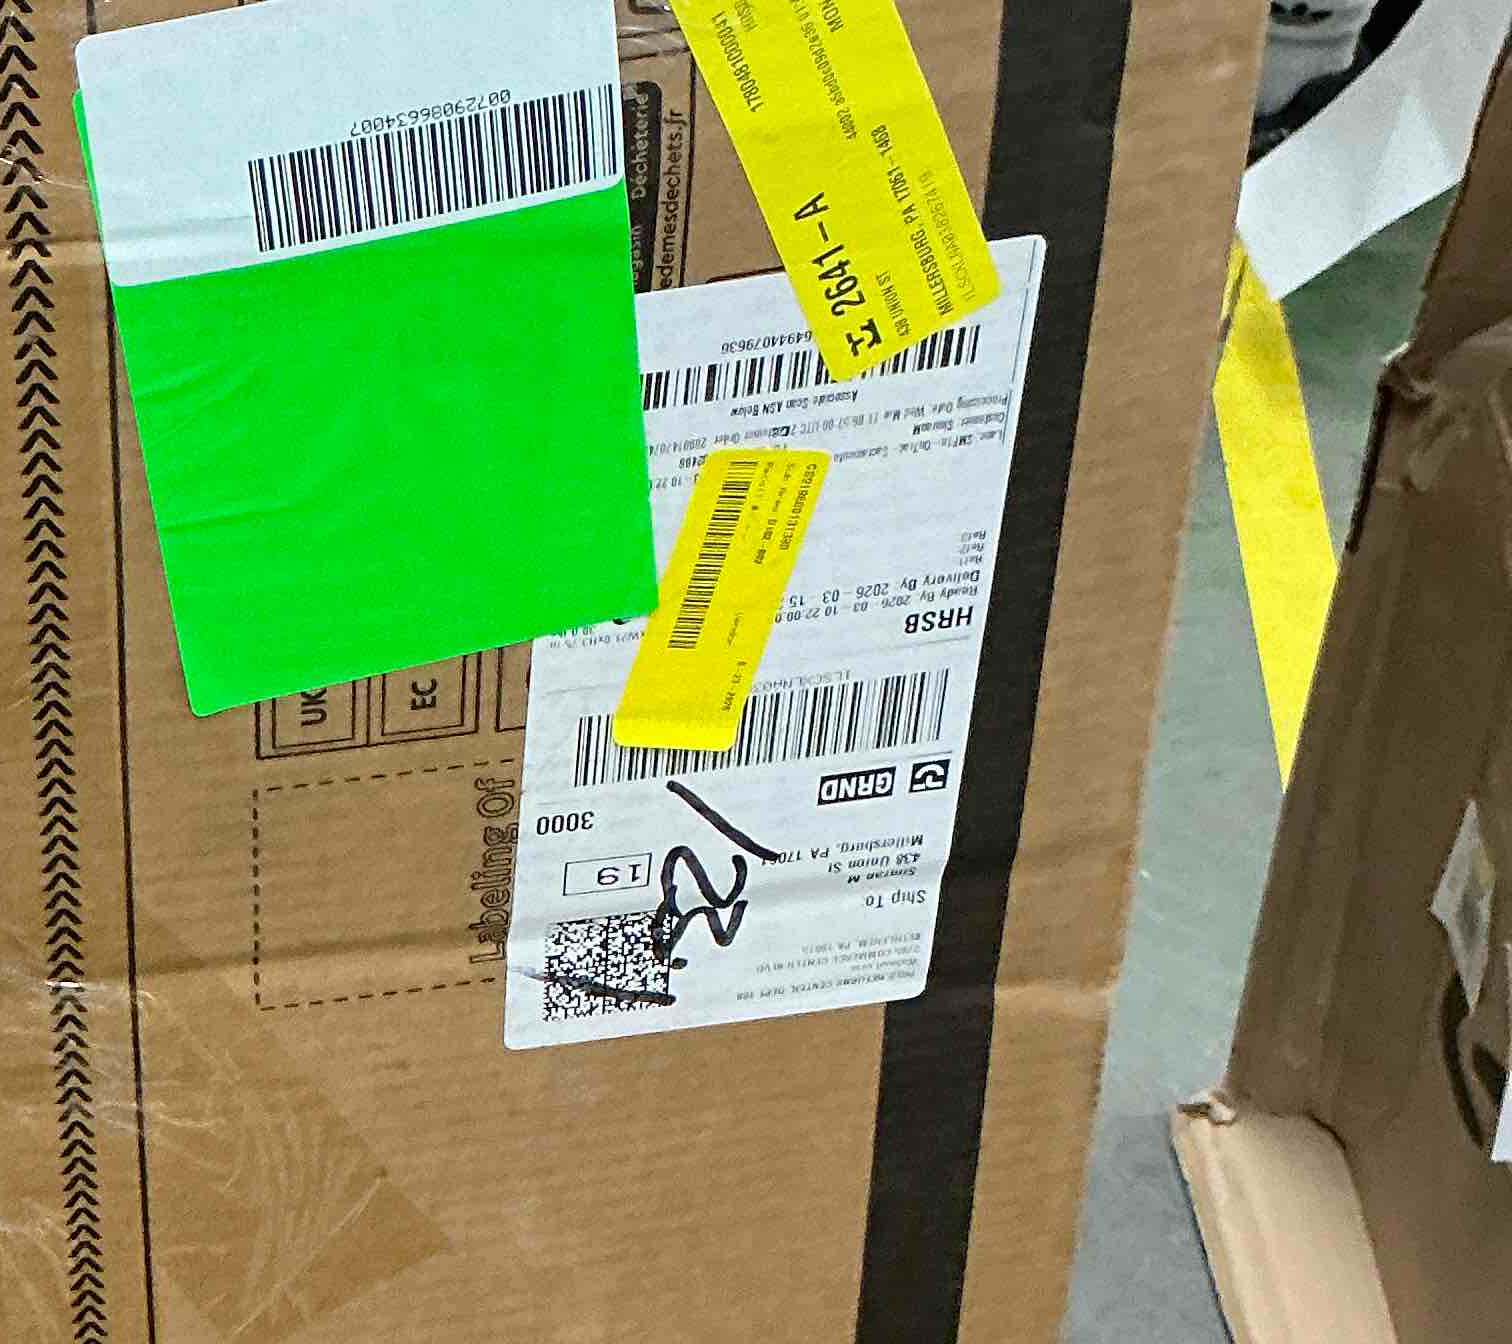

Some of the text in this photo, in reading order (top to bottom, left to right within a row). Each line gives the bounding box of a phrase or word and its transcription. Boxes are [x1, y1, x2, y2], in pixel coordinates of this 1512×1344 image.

[899, 203, 920, 225] PA
[729, 403, 759, 419] Below
[762, 400, 783, 414] ASN
[785, 396, 808, 410] Scan
[899, 575, 917, 591] By
[923, 567, 979, 588] Delivery
[939, 583, 977, 599] Ready
[902, 605, 973, 634] HRSB
[410, 677, 438, 710] EC
[819, 771, 893, 801] GRND
[536, 809, 594, 835] 3000
[809, 845, 829, 859] PA
[847, 855, 889, 870] Union
[469, 775, 520, 964] Labeling Of
[597, 862, 641, 885] 19
[863, 886, 927, 910] Ship To
